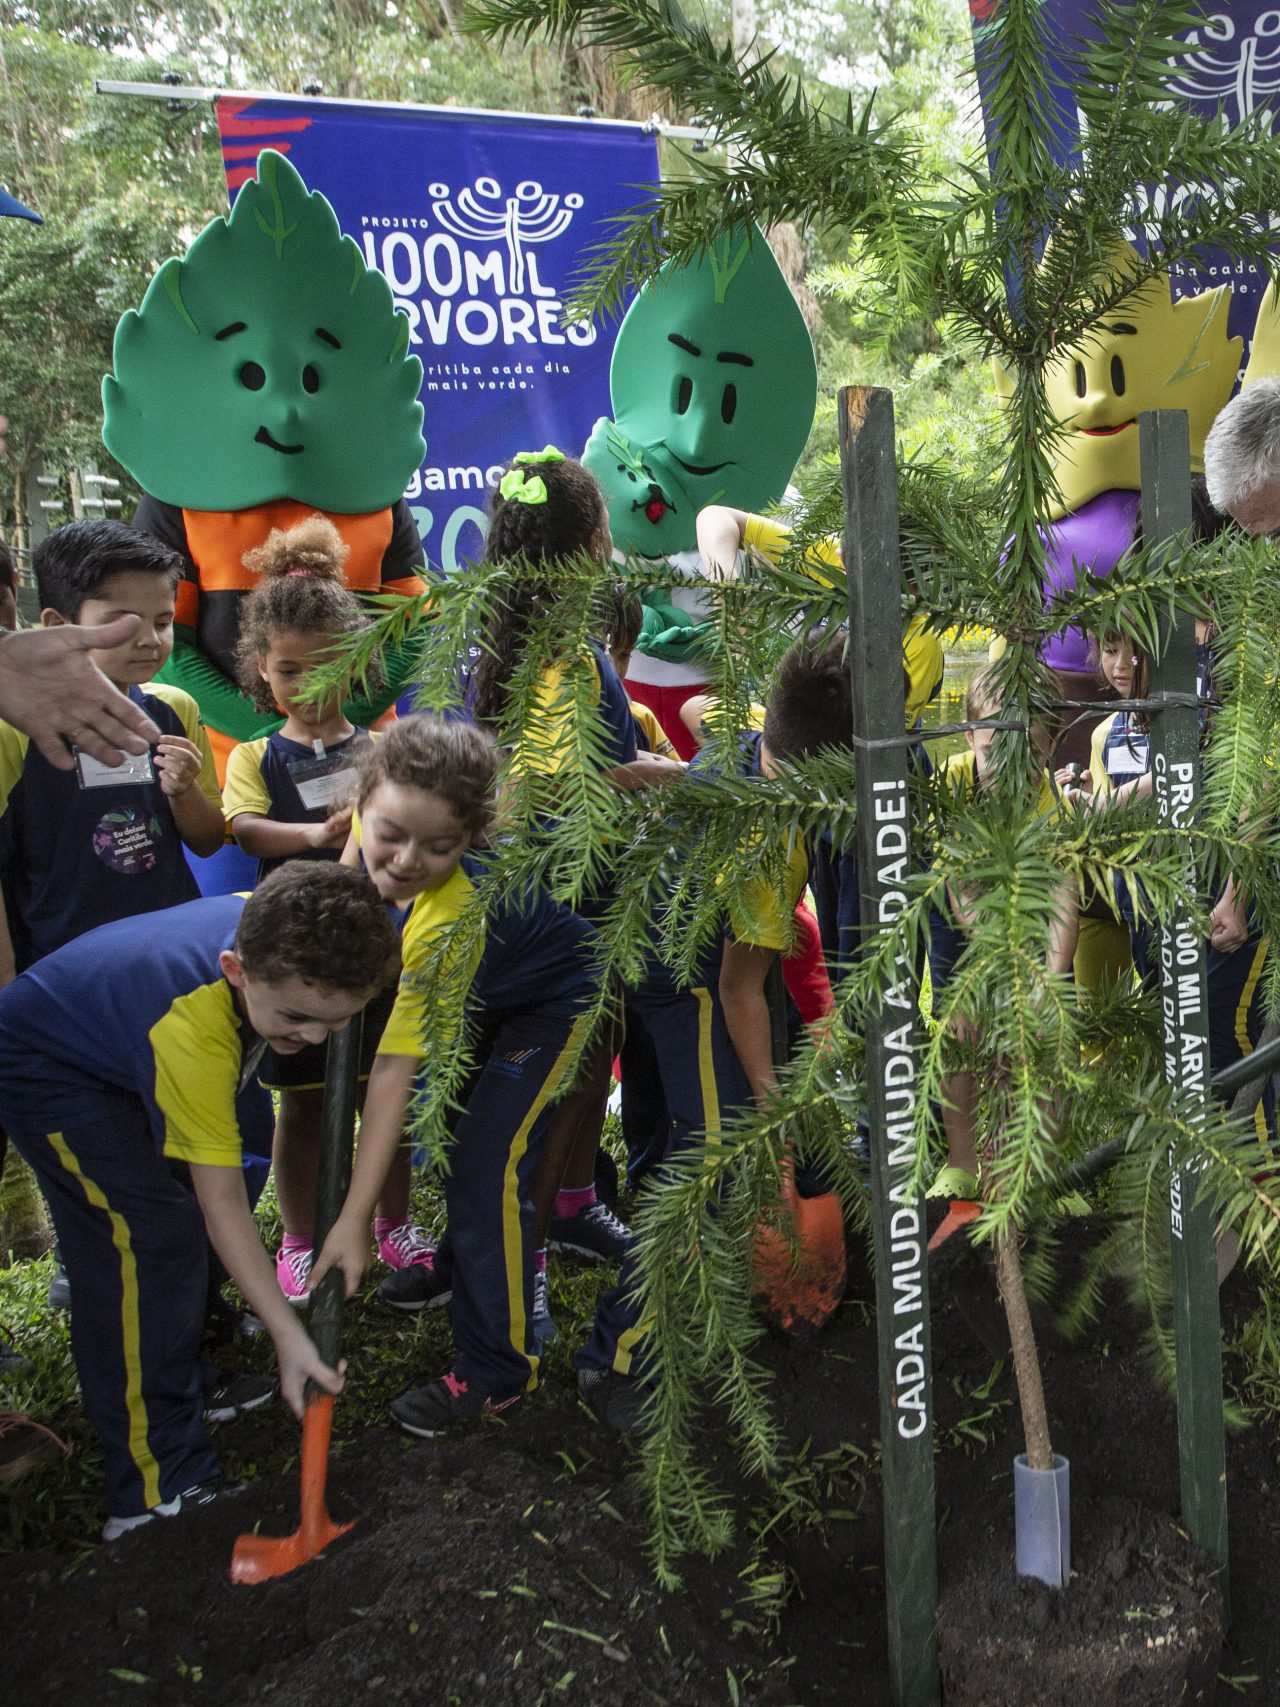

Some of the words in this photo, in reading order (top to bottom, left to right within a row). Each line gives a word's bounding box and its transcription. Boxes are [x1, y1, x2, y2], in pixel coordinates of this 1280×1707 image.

[361, 216, 429, 229] PROJETO
[492, 362, 534, 374] cada
[544, 360, 570, 374] dia
[427, 379, 468, 391] mais
[478, 377, 534, 391] verde.
[113, 831, 124, 839] Eu
[117, 832, 147, 846] Curitiba
[114, 845, 134, 856] mais
[1161, 926, 1174, 988] ADA
[1177, 973, 1201, 1027] MIL
[883, 1020, 917, 1167] MUDA
[889, 1182, 922, 1315] MUDA
[894, 1321, 927, 1439] CADA
